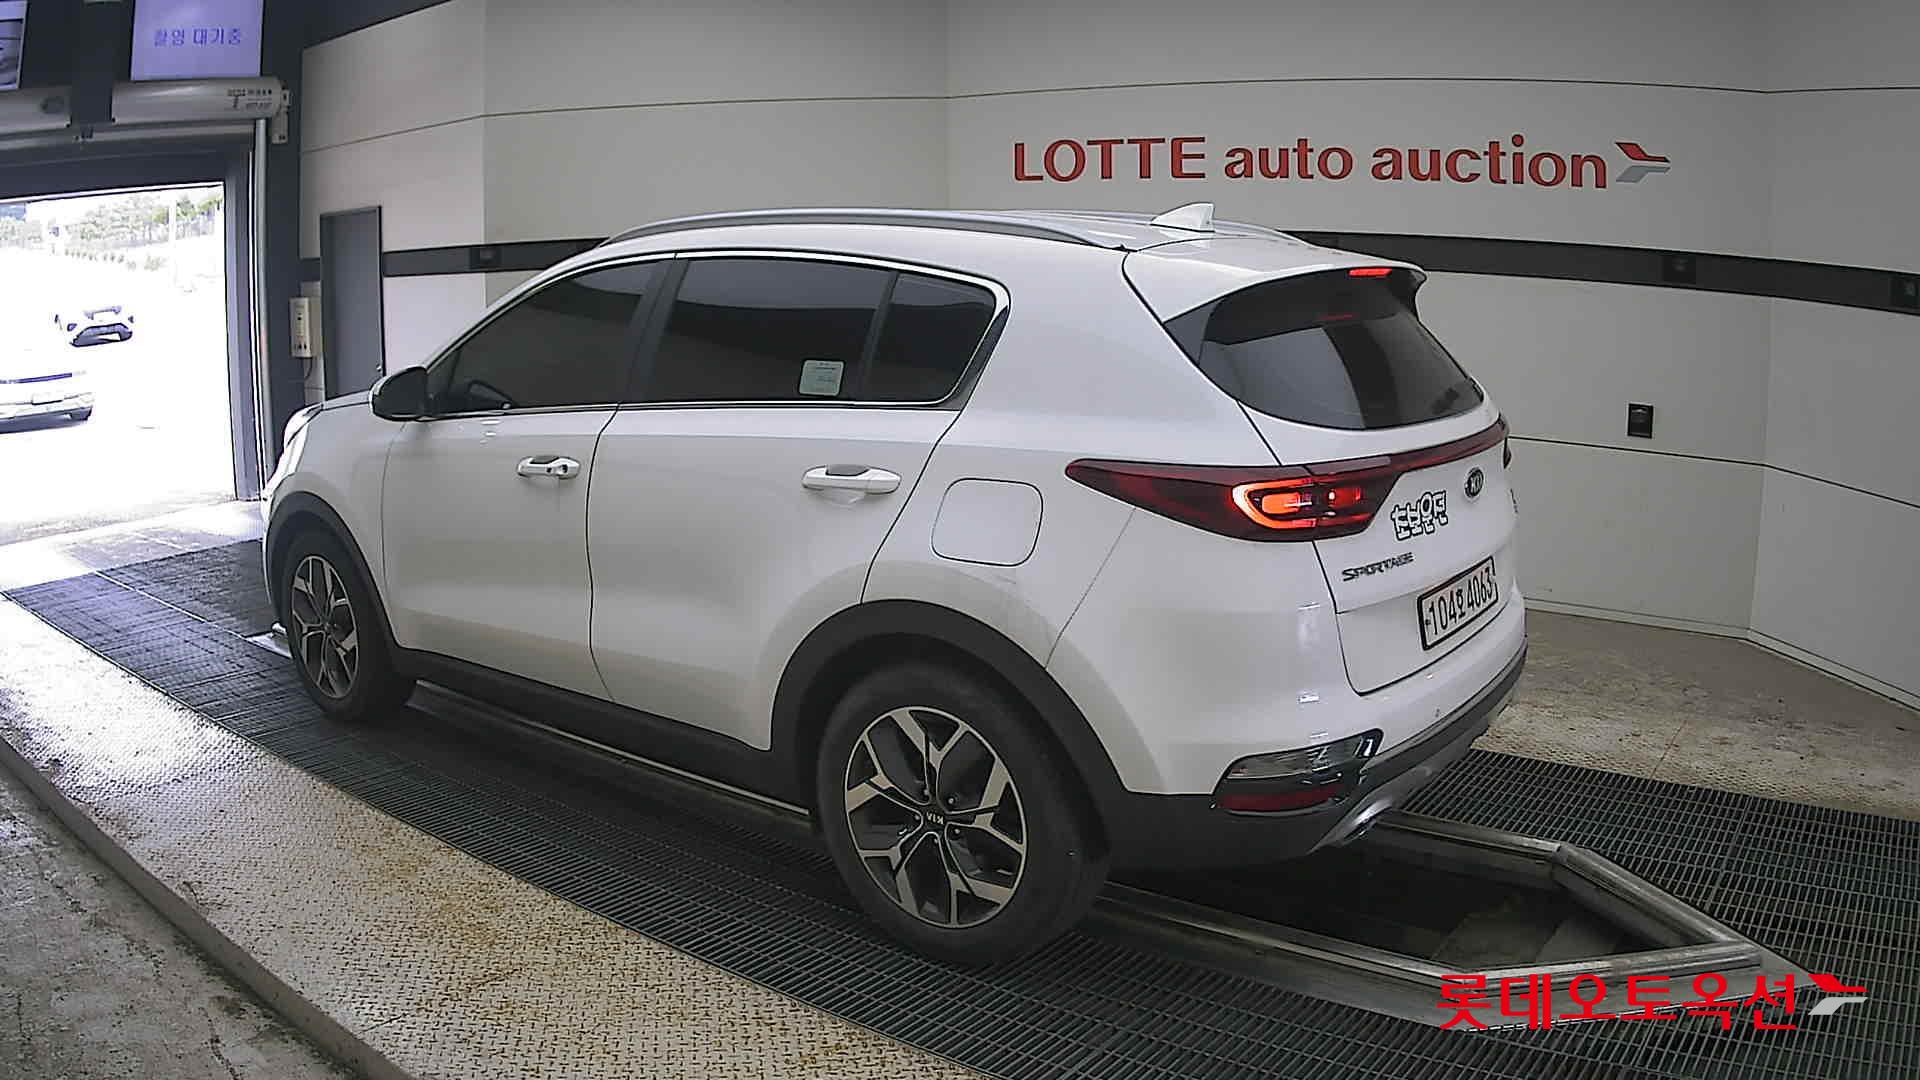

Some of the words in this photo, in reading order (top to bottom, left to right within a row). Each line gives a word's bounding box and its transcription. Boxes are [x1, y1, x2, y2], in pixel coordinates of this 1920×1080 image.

[1013, 136, 1206, 182] LOTTE
[1224, 138, 1354, 180] auto
[1370, 133, 1608, 189] auction
[1467, 566, 1493, 610] 4063
[926, 811, 944, 825] KIA
